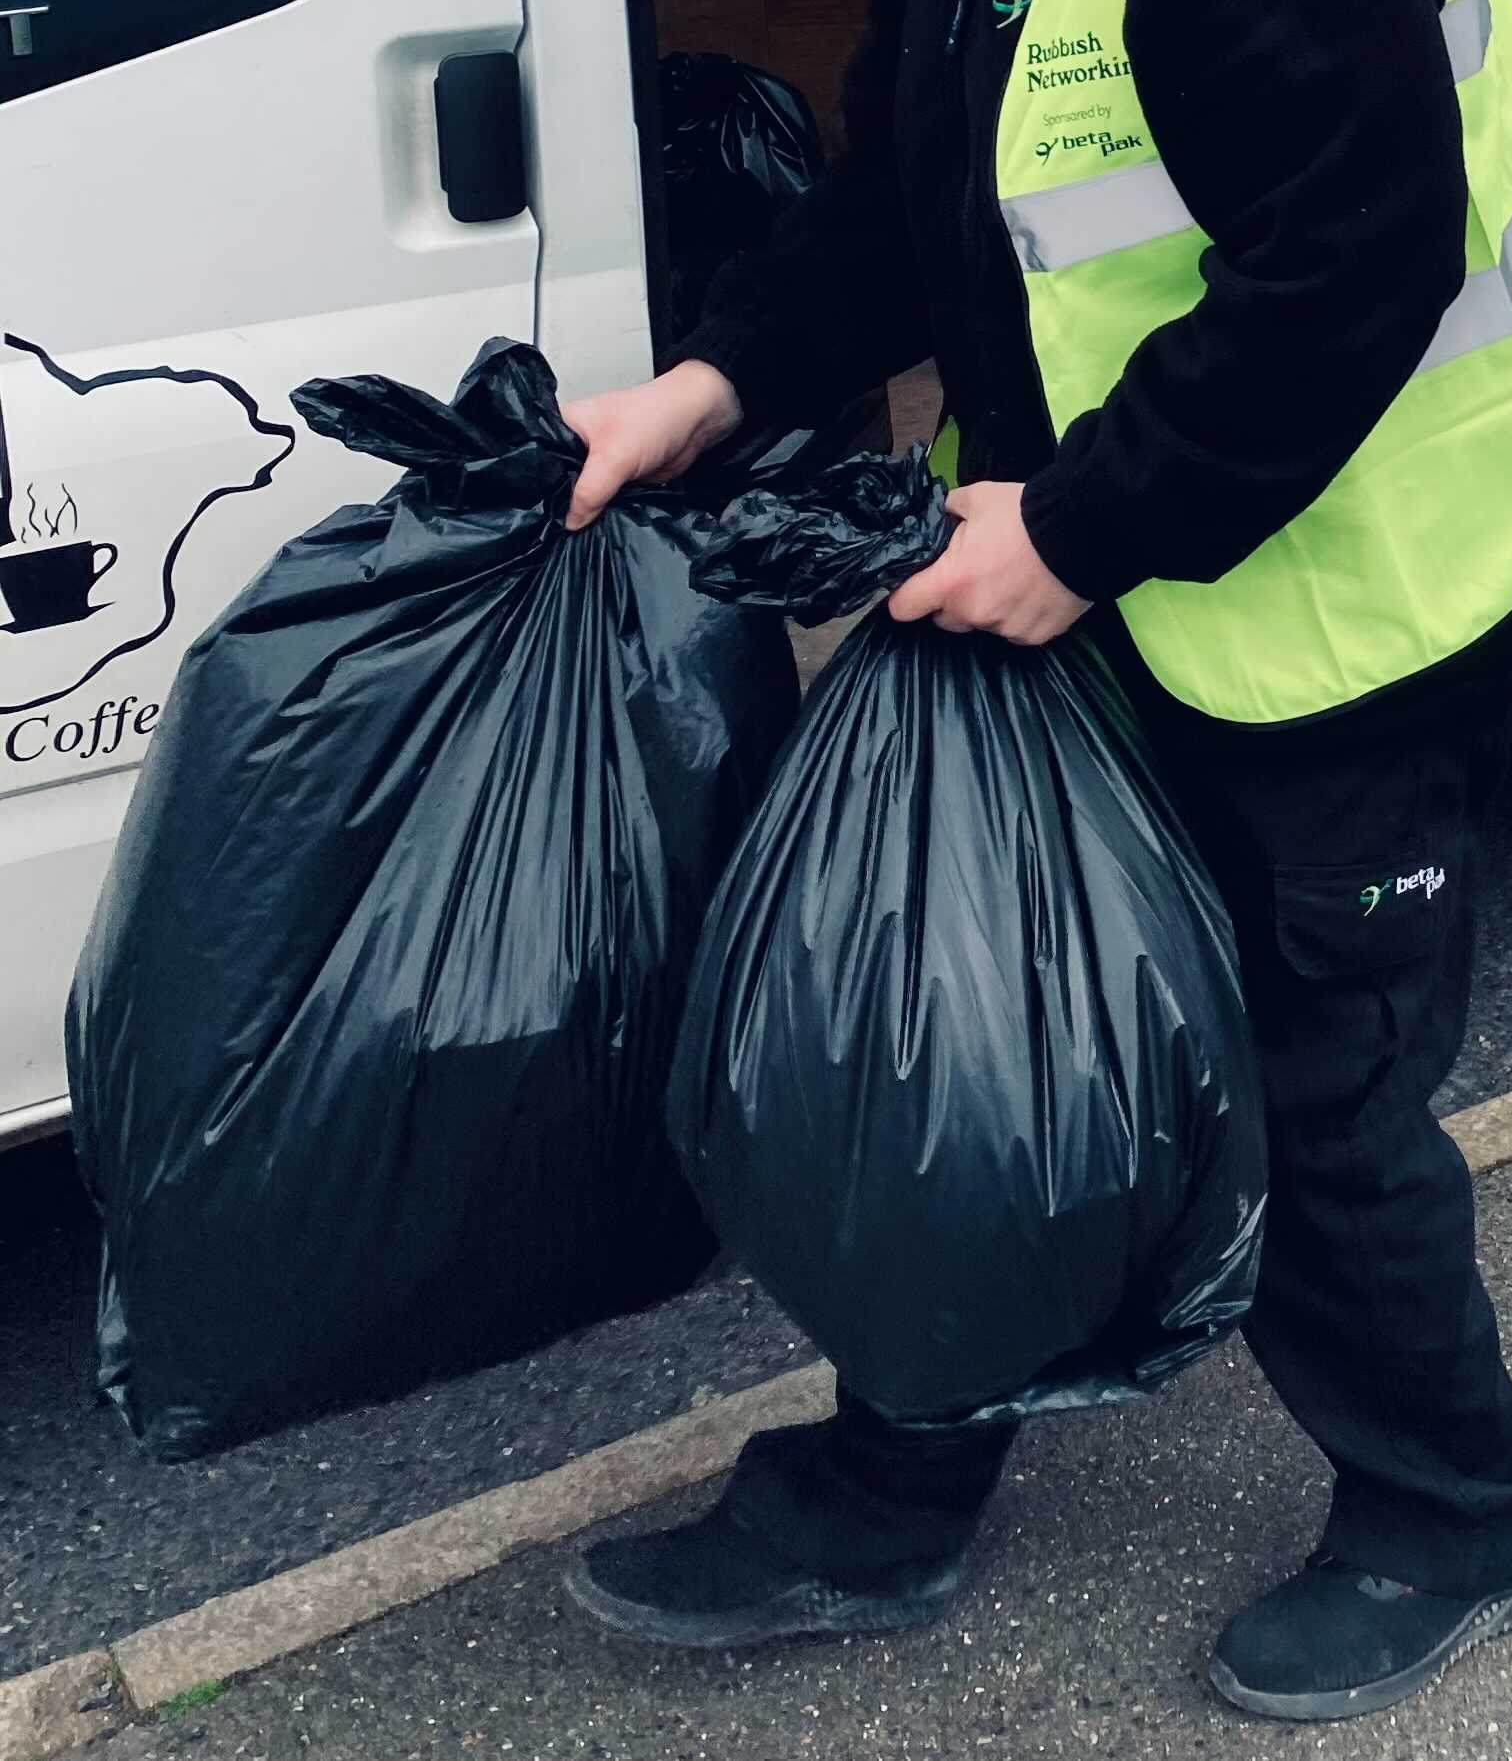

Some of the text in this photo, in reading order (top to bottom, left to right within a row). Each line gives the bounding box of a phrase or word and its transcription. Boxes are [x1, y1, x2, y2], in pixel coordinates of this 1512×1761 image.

[1026, 31, 1104, 65] Rubbish
[1042, 103, 1112, 130] Sponsored by
[1062, 131, 1143, 157] beta pak
[5, 695, 160, 762] Coffe
